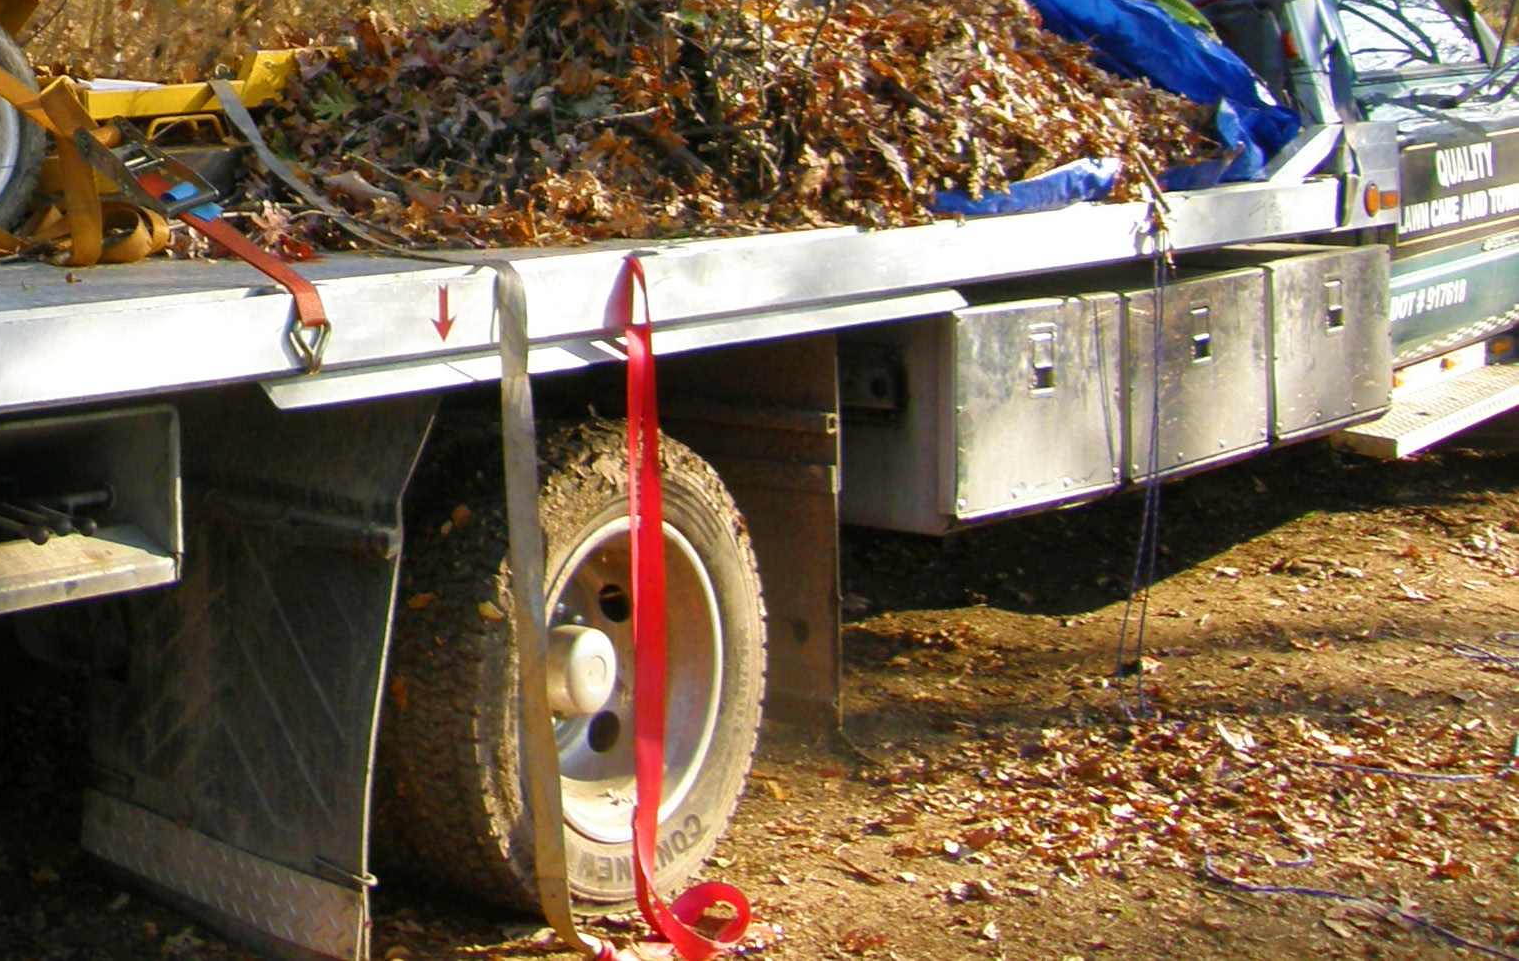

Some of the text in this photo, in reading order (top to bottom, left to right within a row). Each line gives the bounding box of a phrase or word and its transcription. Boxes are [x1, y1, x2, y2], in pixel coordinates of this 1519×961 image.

[1436, 141, 1493, 188] QUALITY
[1430, 195, 1460, 227] CARE
[1461, 189, 1488, 221] AND
[1389, 291, 1417, 322] DOT
